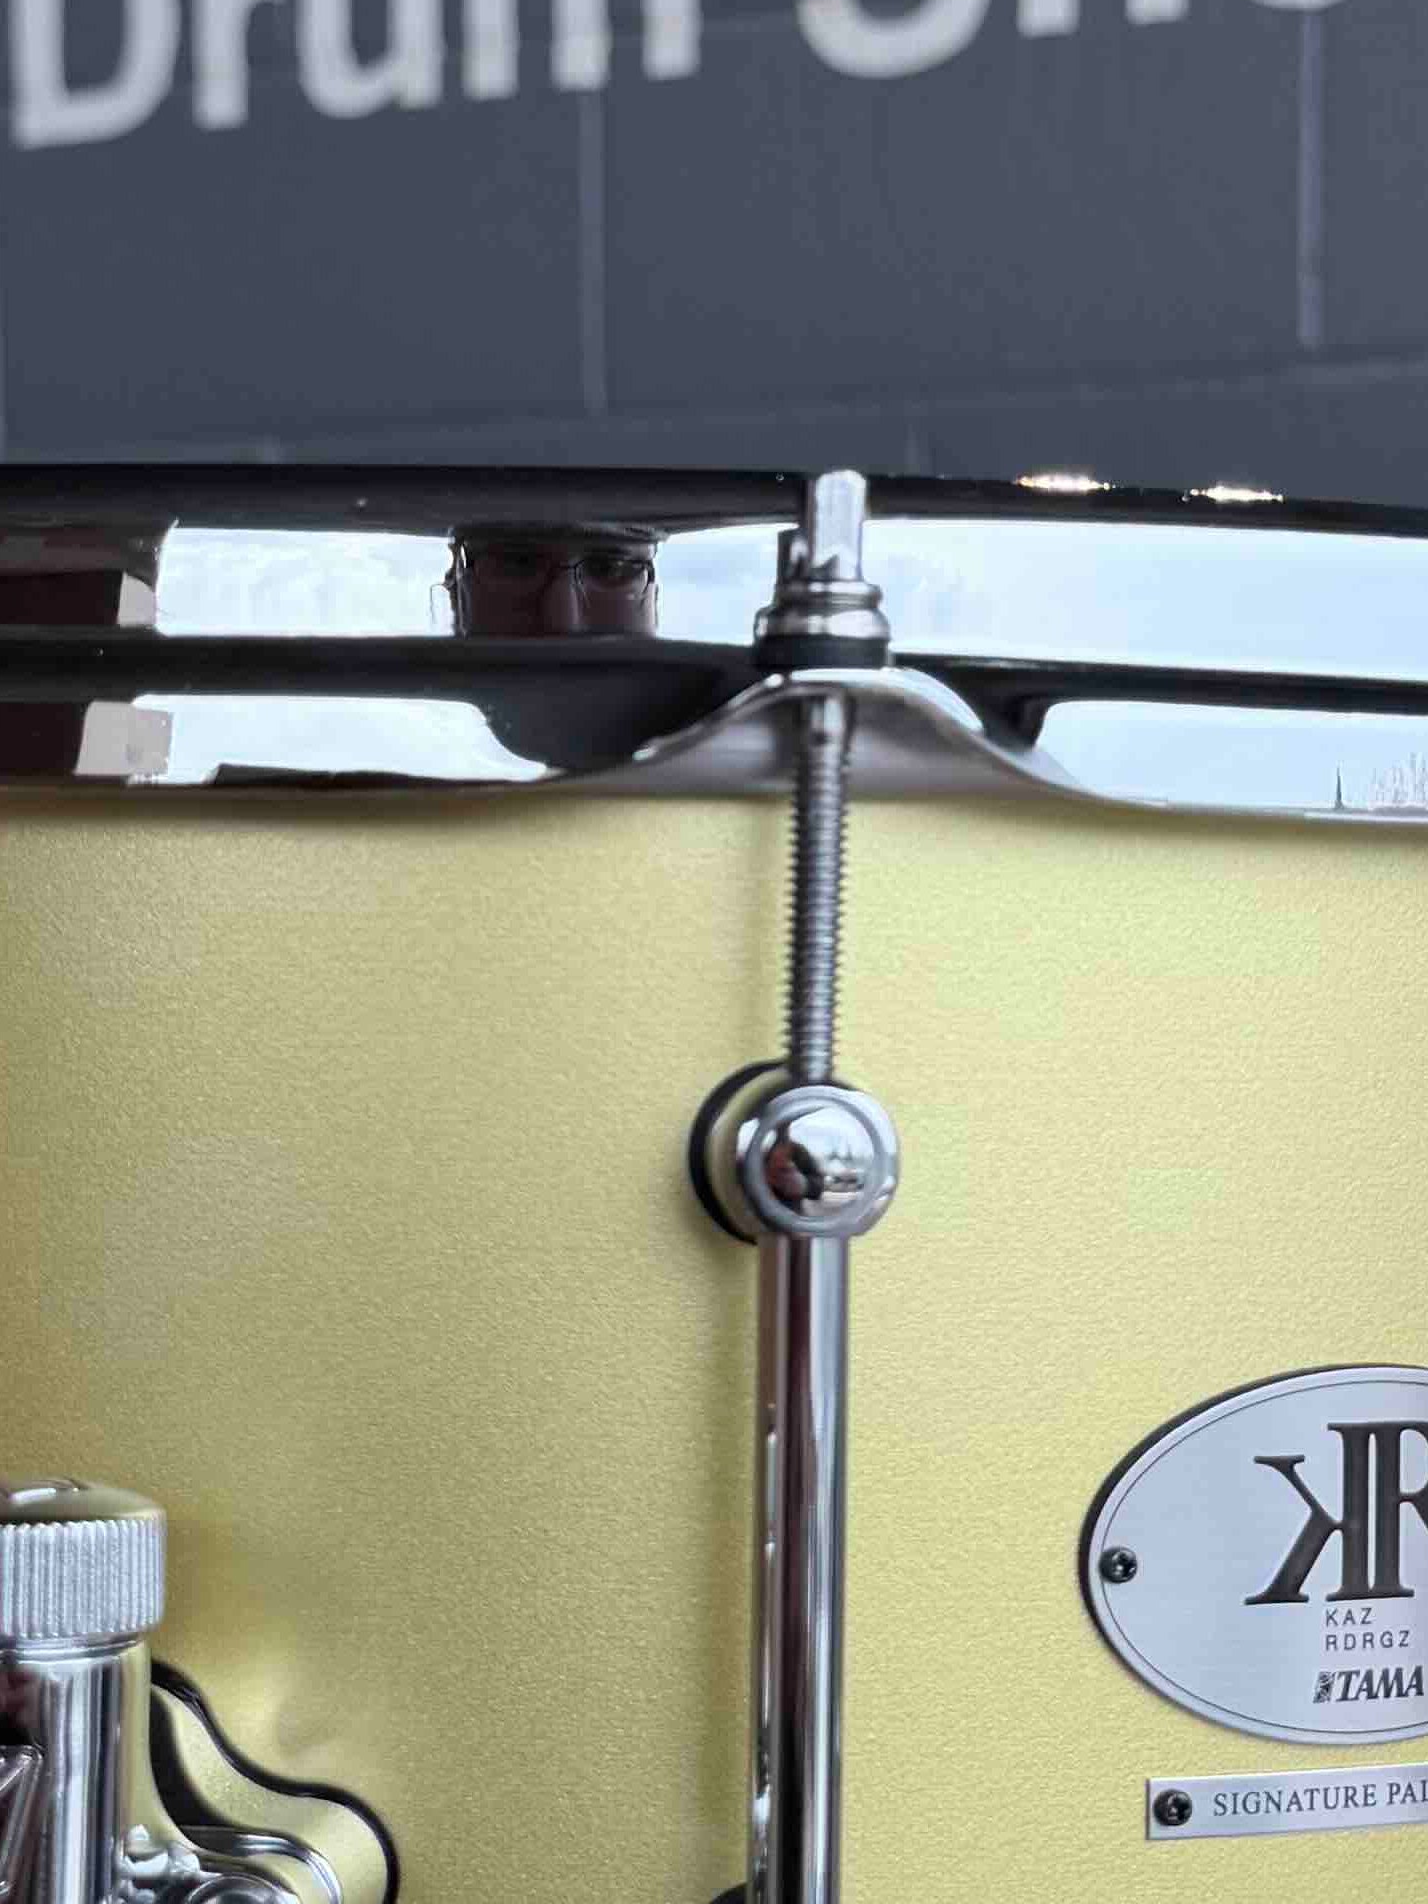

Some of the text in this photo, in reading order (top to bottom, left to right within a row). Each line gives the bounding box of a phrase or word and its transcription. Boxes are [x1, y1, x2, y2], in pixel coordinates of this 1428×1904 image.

[1324, 1606, 1374, 1628] KAZ
[1324, 1629, 1412, 1652] RDRGZ
[1335, 1664, 1426, 1703] TAMA
[1212, 1783, 1378, 1817] SIGNATURE
